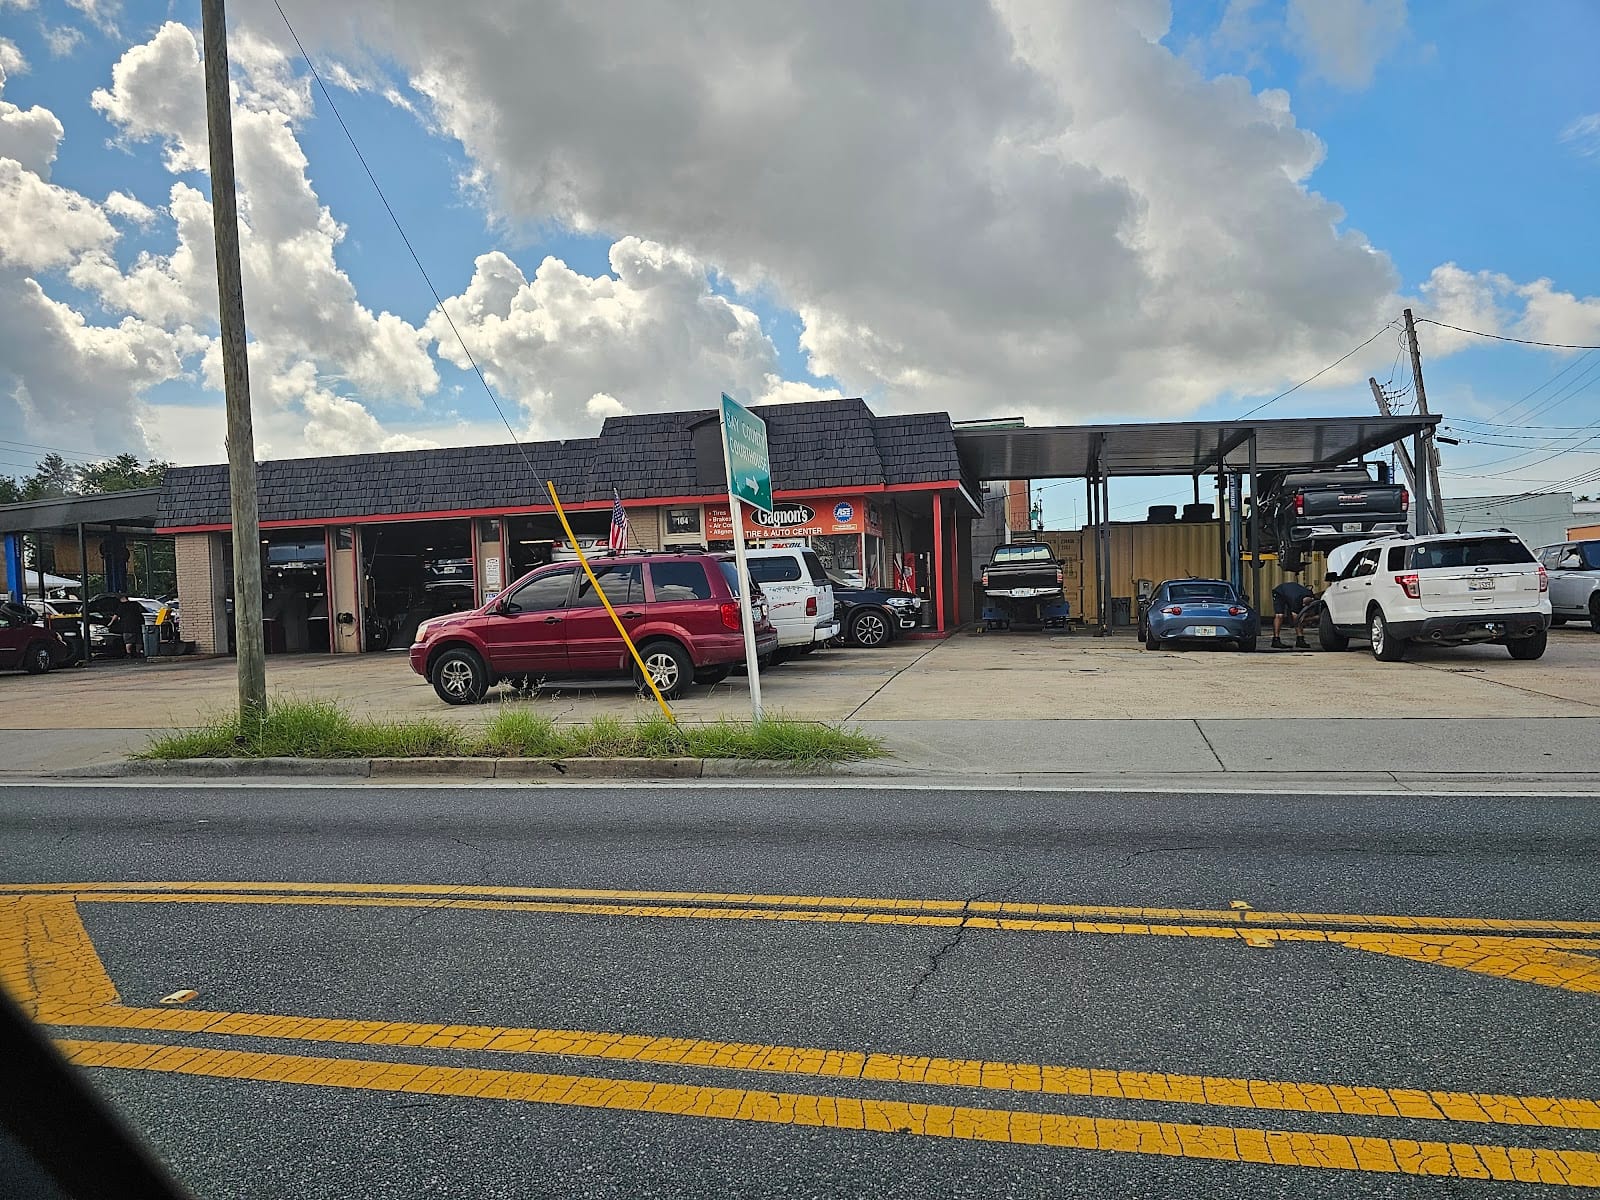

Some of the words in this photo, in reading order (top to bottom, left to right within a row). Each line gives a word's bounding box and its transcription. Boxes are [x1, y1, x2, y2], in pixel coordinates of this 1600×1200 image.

[726, 411, 739, 432] BAY
[742, 422, 765, 451] COUNTY
[730, 437, 768, 473] COURTHOUSE
[757, 504, 808, 528] Gagnon's
[745, 530, 762, 538] TIRE
[771, 529, 790, 537] AUTO
[793, 527, 823, 535] CENTER
